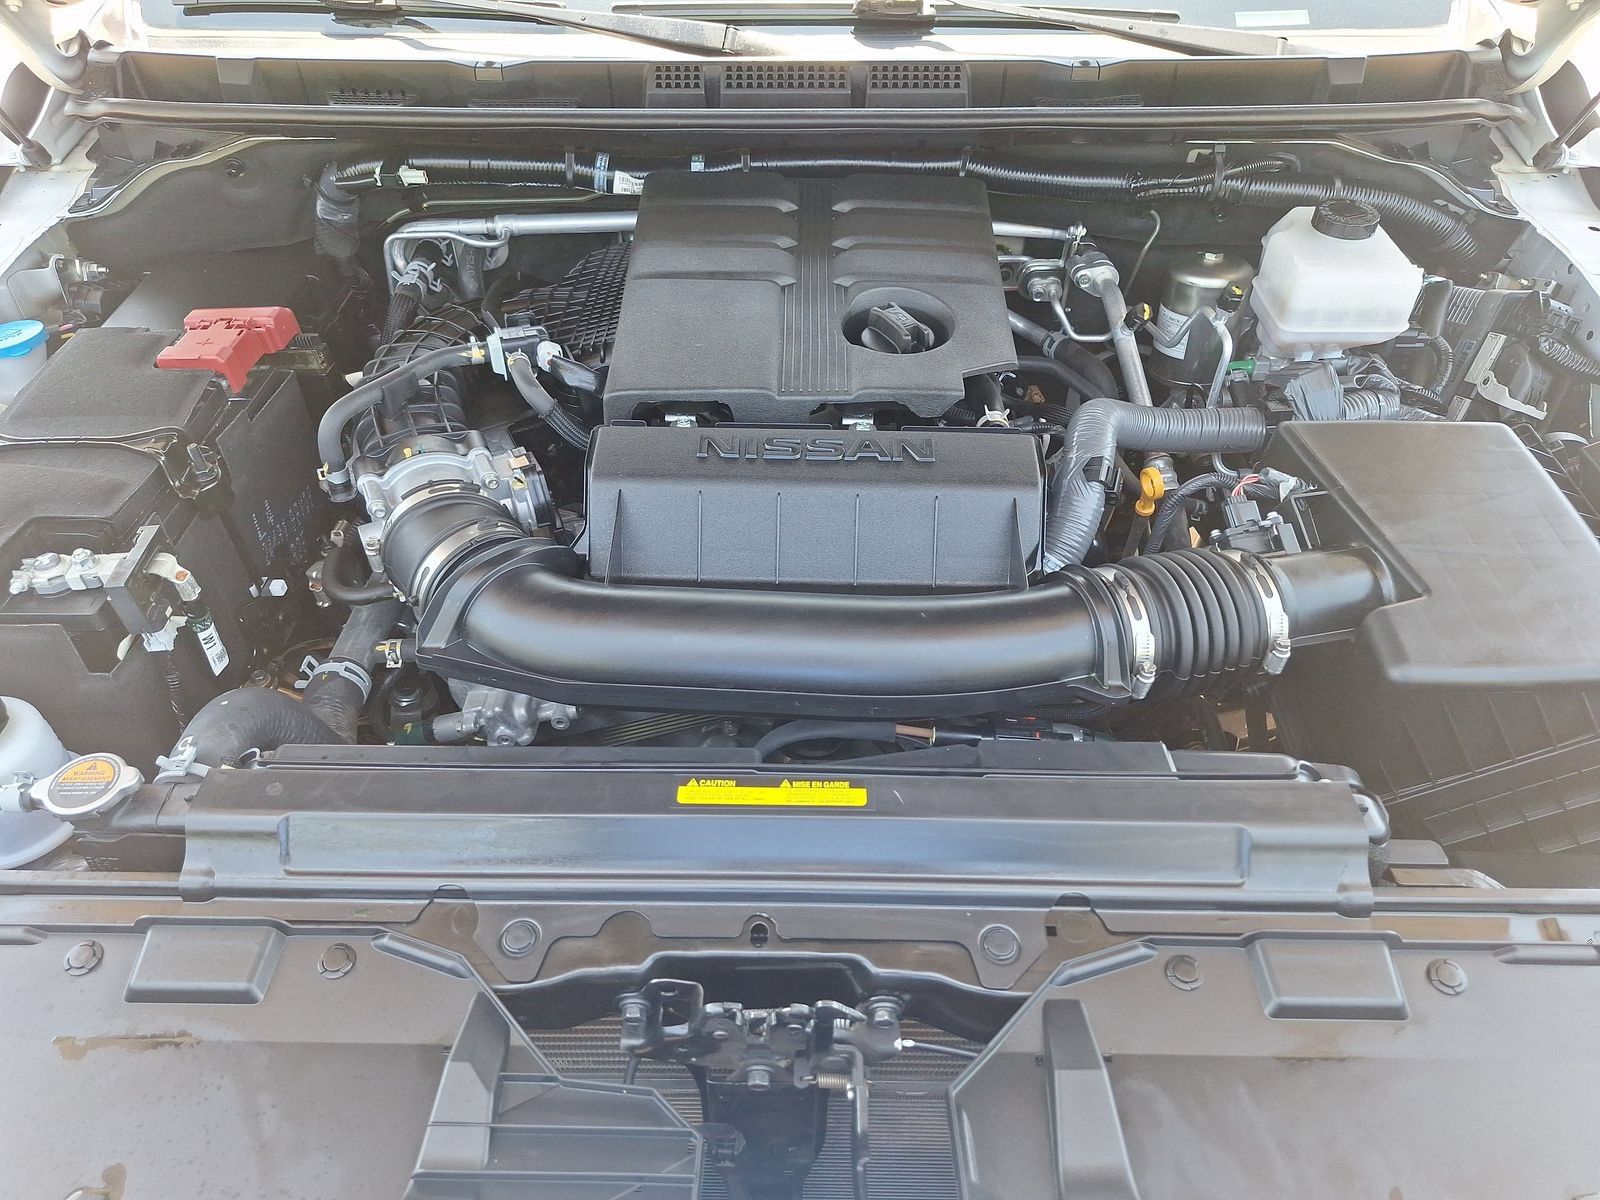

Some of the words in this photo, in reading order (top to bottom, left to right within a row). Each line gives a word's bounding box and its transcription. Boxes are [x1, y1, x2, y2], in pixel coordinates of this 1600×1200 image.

[696, 433, 936, 463] NISSAN
[699, 779, 736, 787] CAUTION
[792, 780, 810, 788] MISE
[823, 781, 850, 789] GARDE
